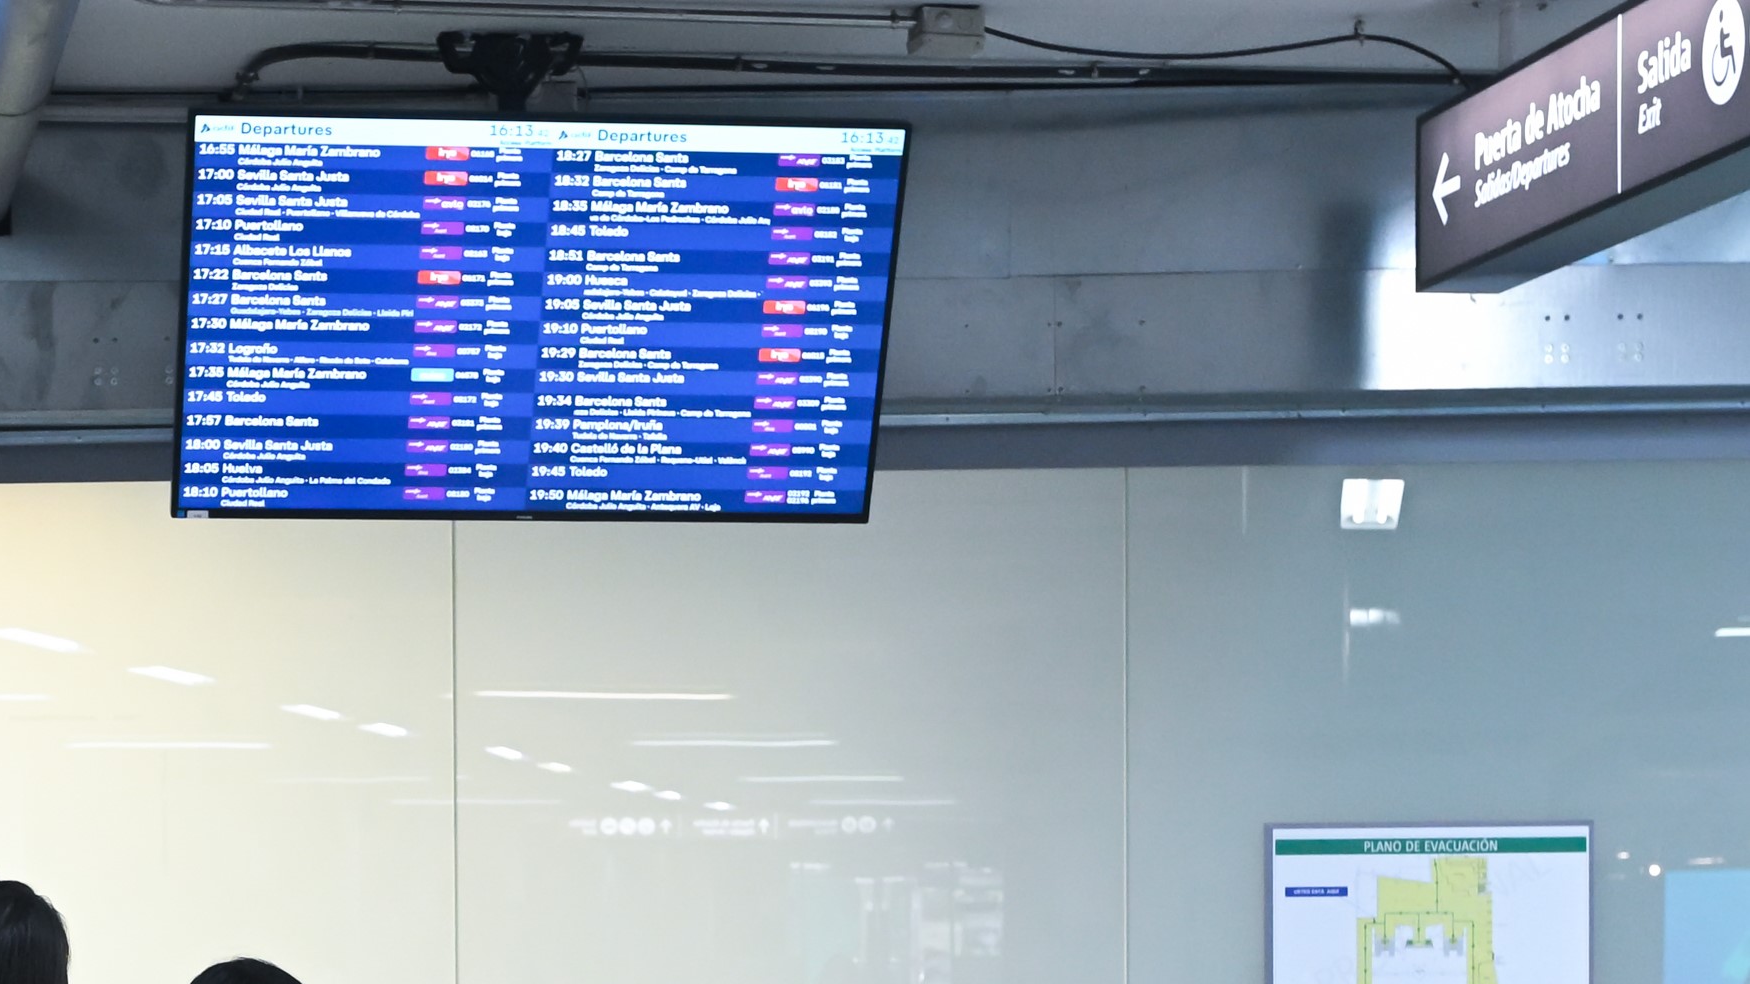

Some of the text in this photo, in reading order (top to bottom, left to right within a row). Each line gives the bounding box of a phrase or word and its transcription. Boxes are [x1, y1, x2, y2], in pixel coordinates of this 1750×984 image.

[1638, 31, 1691, 93] Salida
[1639, 97, 1661, 133] Exit
[1475, 76, 1600, 170] Puerta de Atocha
[241, 122, 332, 138] Departures
[490, 124, 533, 136] 16:13
[598, 129, 687, 144] Departures
[842, 131, 885, 144] 16:13
[200, 144, 380, 157] 16:55 Málaga María Zambrano
[199, 169, 349, 181] 17:00 Sevilla Santa Justa
[555, 175, 589, 186] 18:32
[593, 176, 651, 187] Barcelona
[196, 219, 303, 231] 17:10 Puertollano
[551, 225, 628, 236] 18:45 Toledo
[195, 244, 351, 257] 17:15 Albacete Los Llanos
[194, 269, 327, 281] 17:22 Barcelona Sants
[548, 274, 628, 285] 19:00 Huesca
[546, 299, 691, 311] 19:05 Sevilla Santa Justa
[190, 342, 277, 357] 17:32 Logroño
[188, 391, 266, 402] 17:45 Toledo
[536, 419, 662, 431] 19:39 Pamplona/Iruña
[534, 443, 681, 454] 19:40 Castelló de la Plana
[185, 463, 262, 473] 18:05 Huelva
[532, 466, 607, 476] 19:45 Toledo
[184, 487, 288, 497] 18:10 Puertollano
[530, 490, 701, 502] 19:50 Málaga María Zambrano
[1365, 839, 1497, 852] PLANO DE EVACUACIÓN
